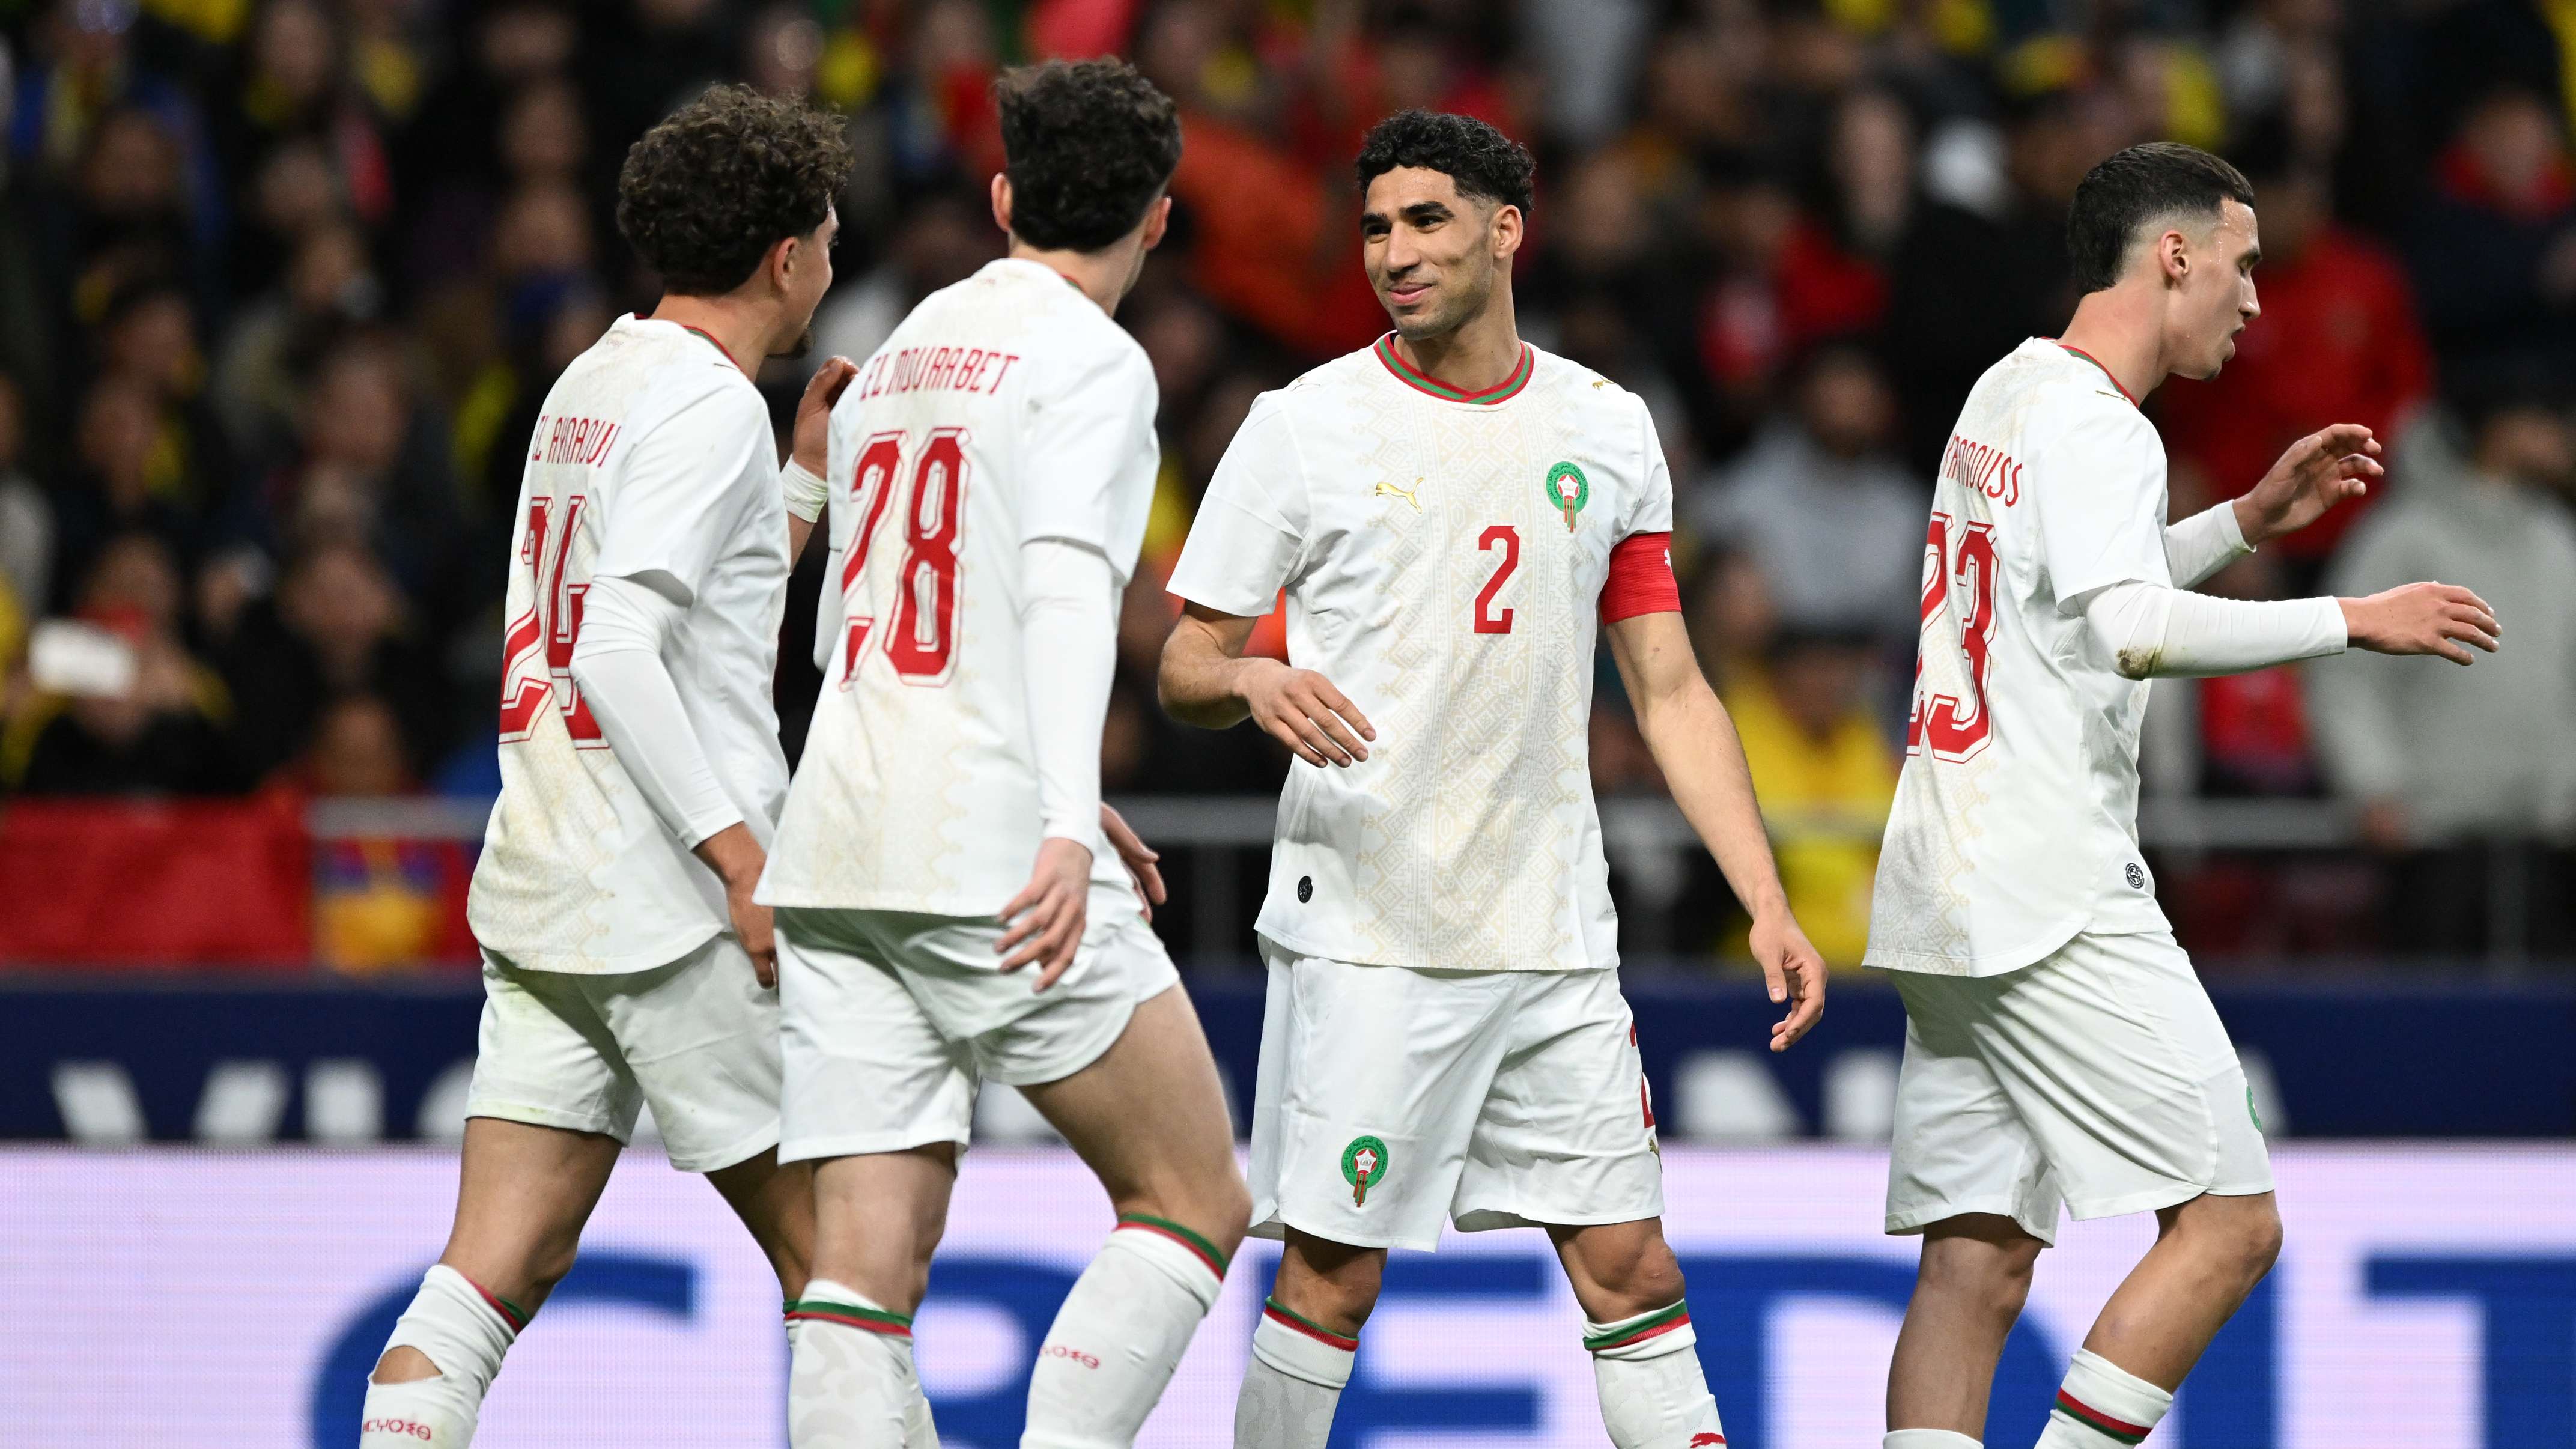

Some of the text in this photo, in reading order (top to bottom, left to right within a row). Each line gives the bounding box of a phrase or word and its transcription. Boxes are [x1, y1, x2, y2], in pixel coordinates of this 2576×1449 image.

[547, 416, 621, 468] AYNAOUI
[859, 345, 1020, 401] EL MOURABET
[497, 494, 610, 750] 24
[838, 426, 972, 693] 28
[1474, 525, 1520, 634] 2
[1906, 511, 2000, 764] 23
